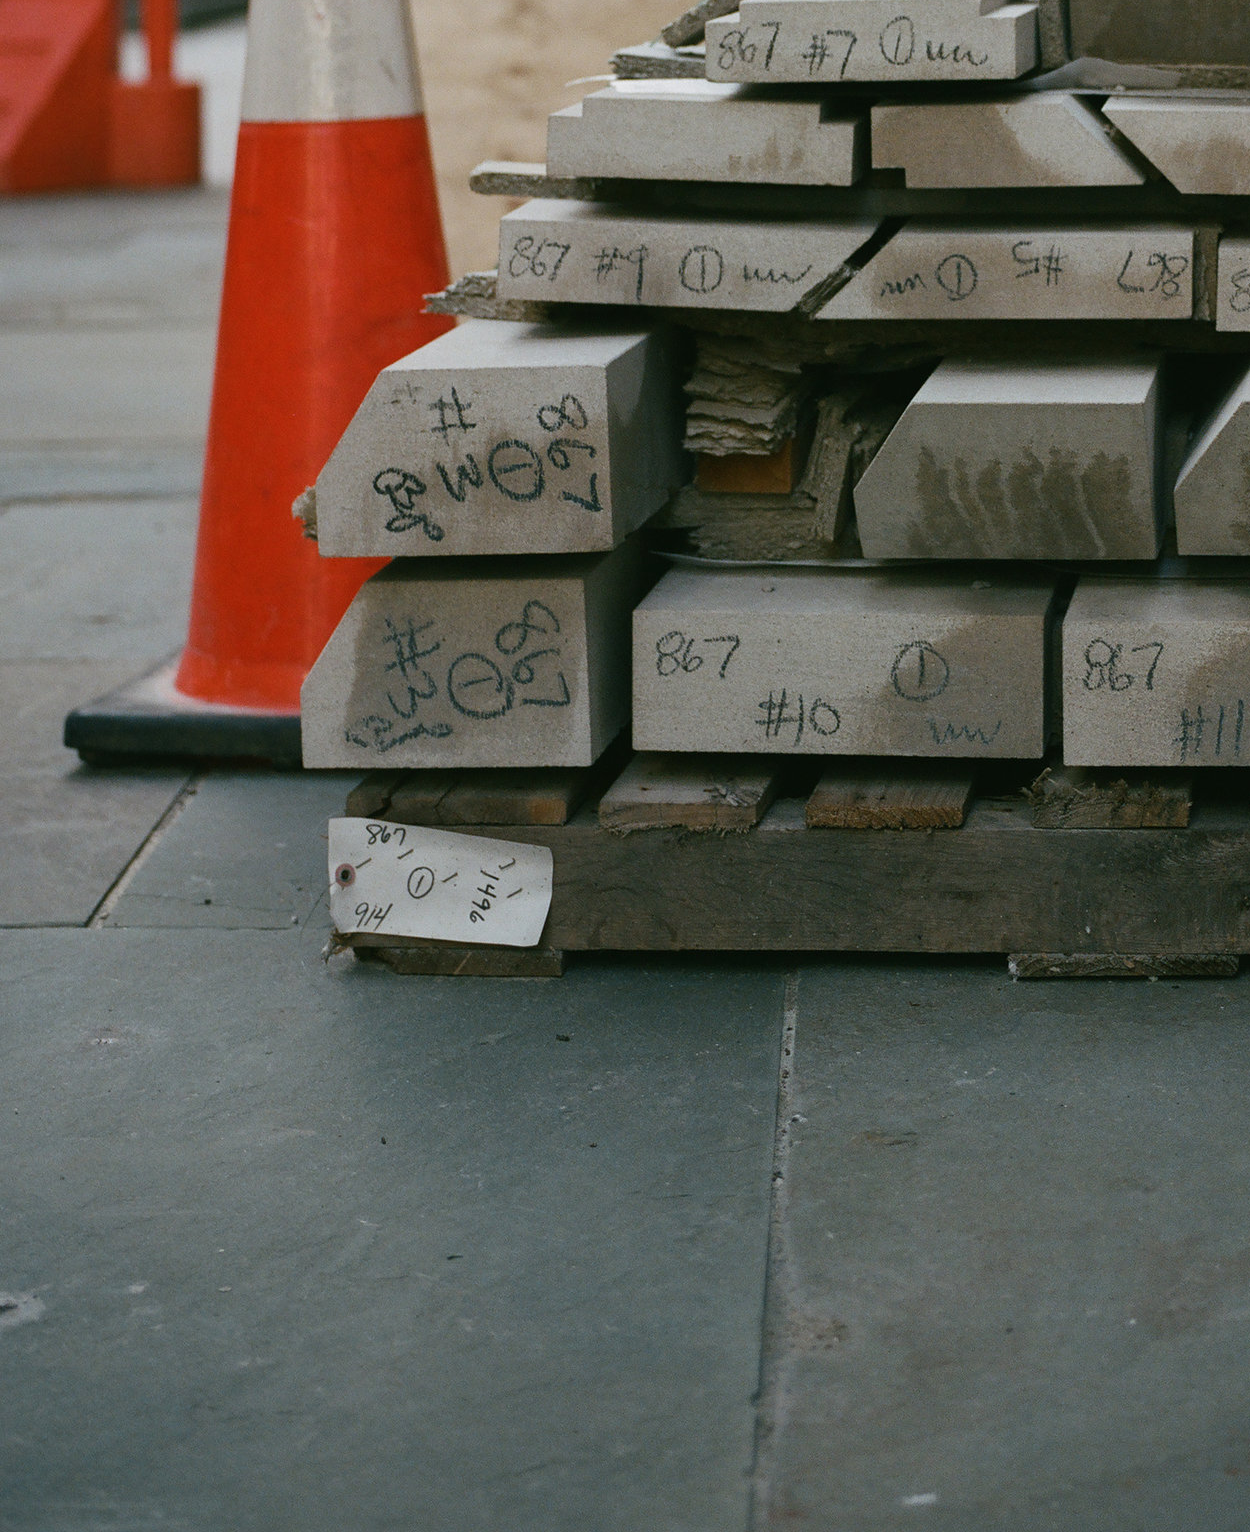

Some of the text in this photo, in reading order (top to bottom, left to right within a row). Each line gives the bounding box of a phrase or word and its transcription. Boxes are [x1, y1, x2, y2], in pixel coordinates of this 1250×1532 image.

[718, 20, 782, 70] 867
[802, 29, 857, 79] #7
[508, 235, 571, 281] 867
[536, 392, 604, 513] 867
[495, 599, 571, 707] 867
[656, 630, 740, 679] 867
[1081, 638, 1164, 692] 867
[755, 687, 841, 747] #10
[365, 823, 406, 846] 867
[468, 869, 500, 924] 1496
